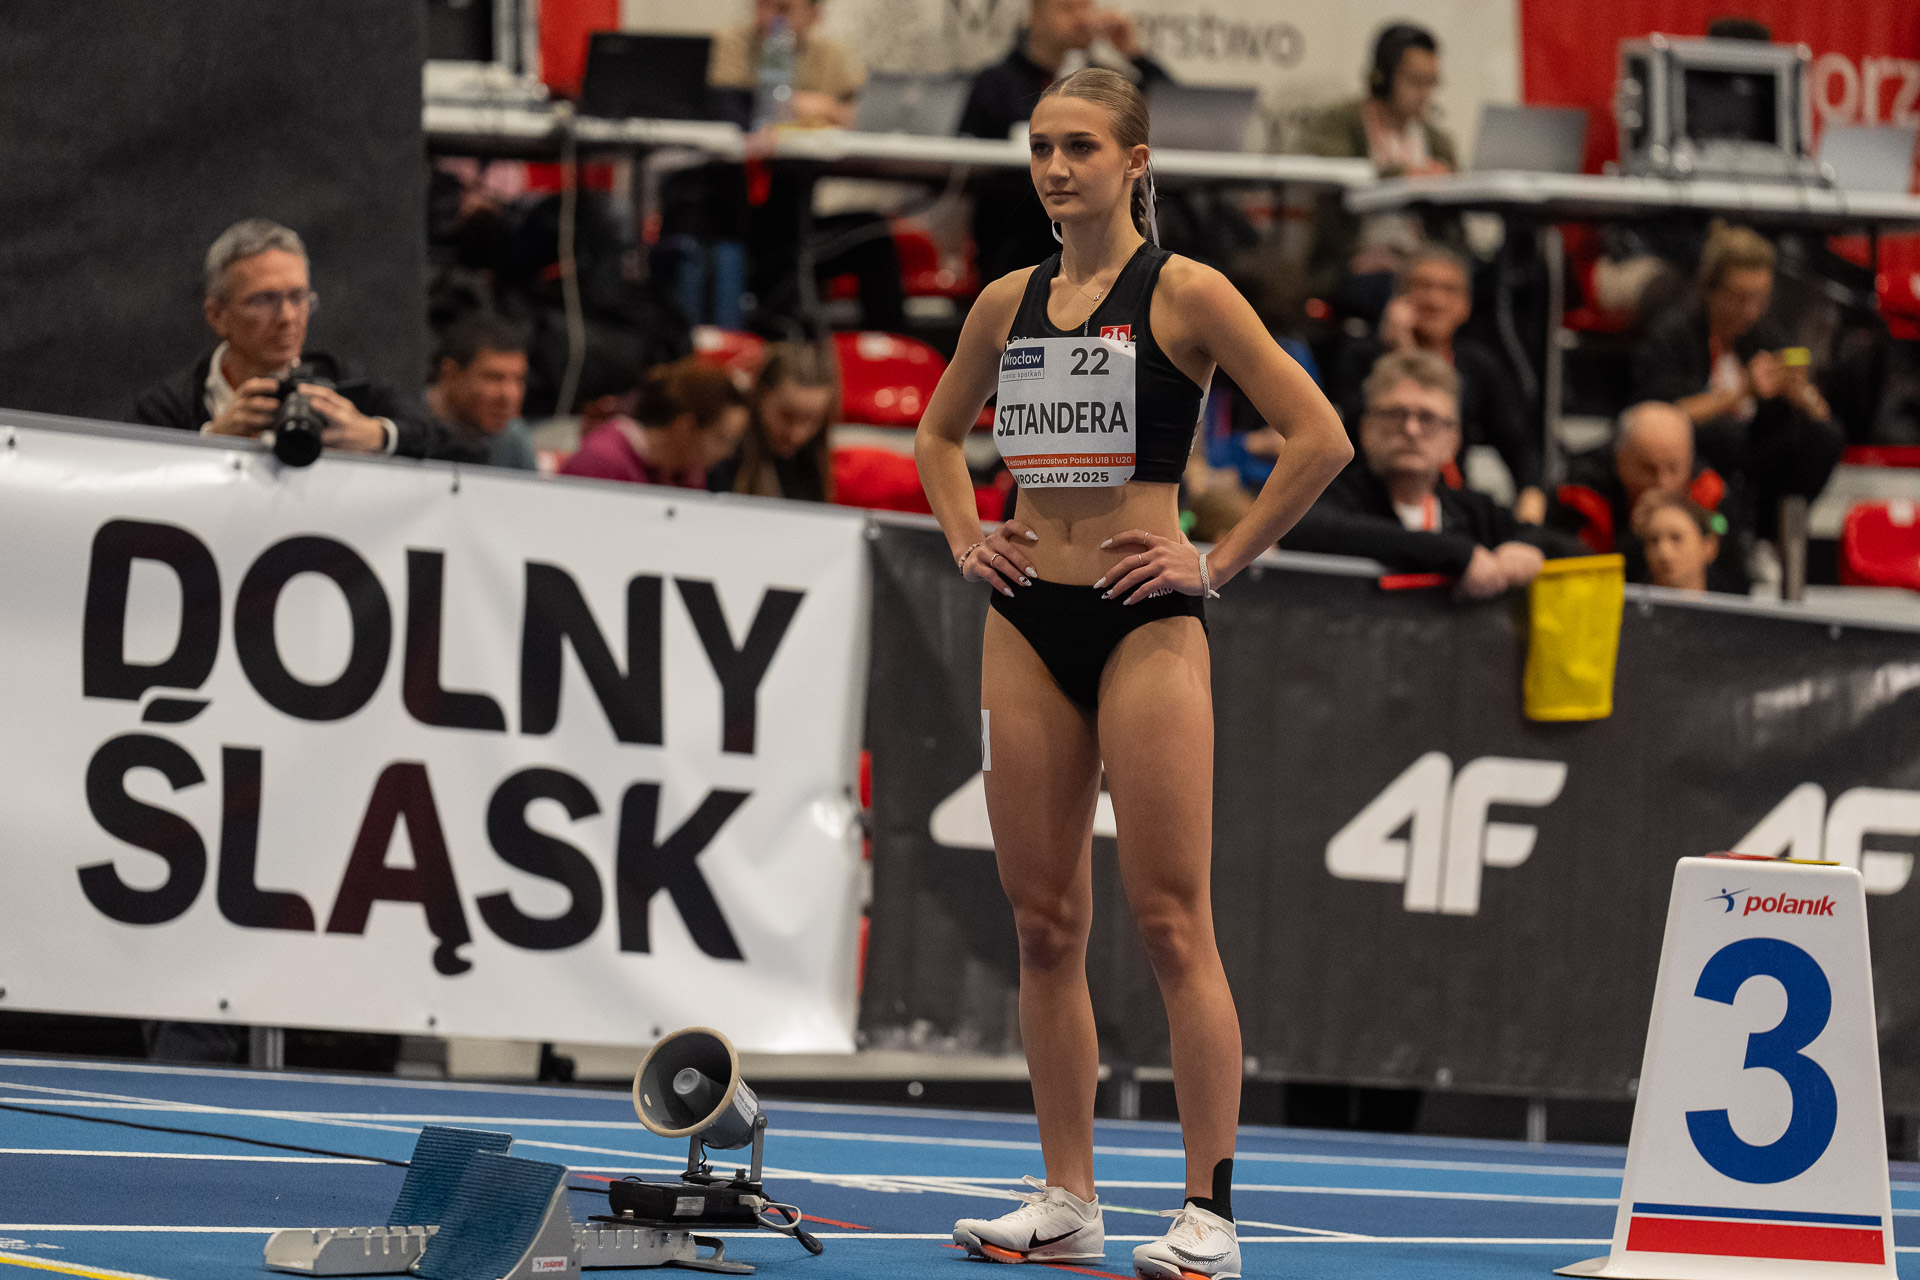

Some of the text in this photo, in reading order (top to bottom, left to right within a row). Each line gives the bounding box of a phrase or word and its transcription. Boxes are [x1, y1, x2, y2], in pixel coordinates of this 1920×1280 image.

[1004, 350, 1042, 366] Wrocław
[1070, 347, 1110, 376] 22
[997, 401, 1129, 437] SZTANDERA
[1027, 457, 1068, 466] Mistrzostwa
[1069, 456, 1093, 465] Polski
[1095, 456, 1110, 465] U18
[1115, 456, 1132, 464] U20
[1072, 471, 1110, 483] 2025
[82, 517, 808, 756] DOLNY
[76, 696, 754, 976] ŚLĄSK
[1325, 751, 1568, 915] 4F
[1743, 892, 1837, 916] polanik
[1685, 937, 1838, 1184] 3
